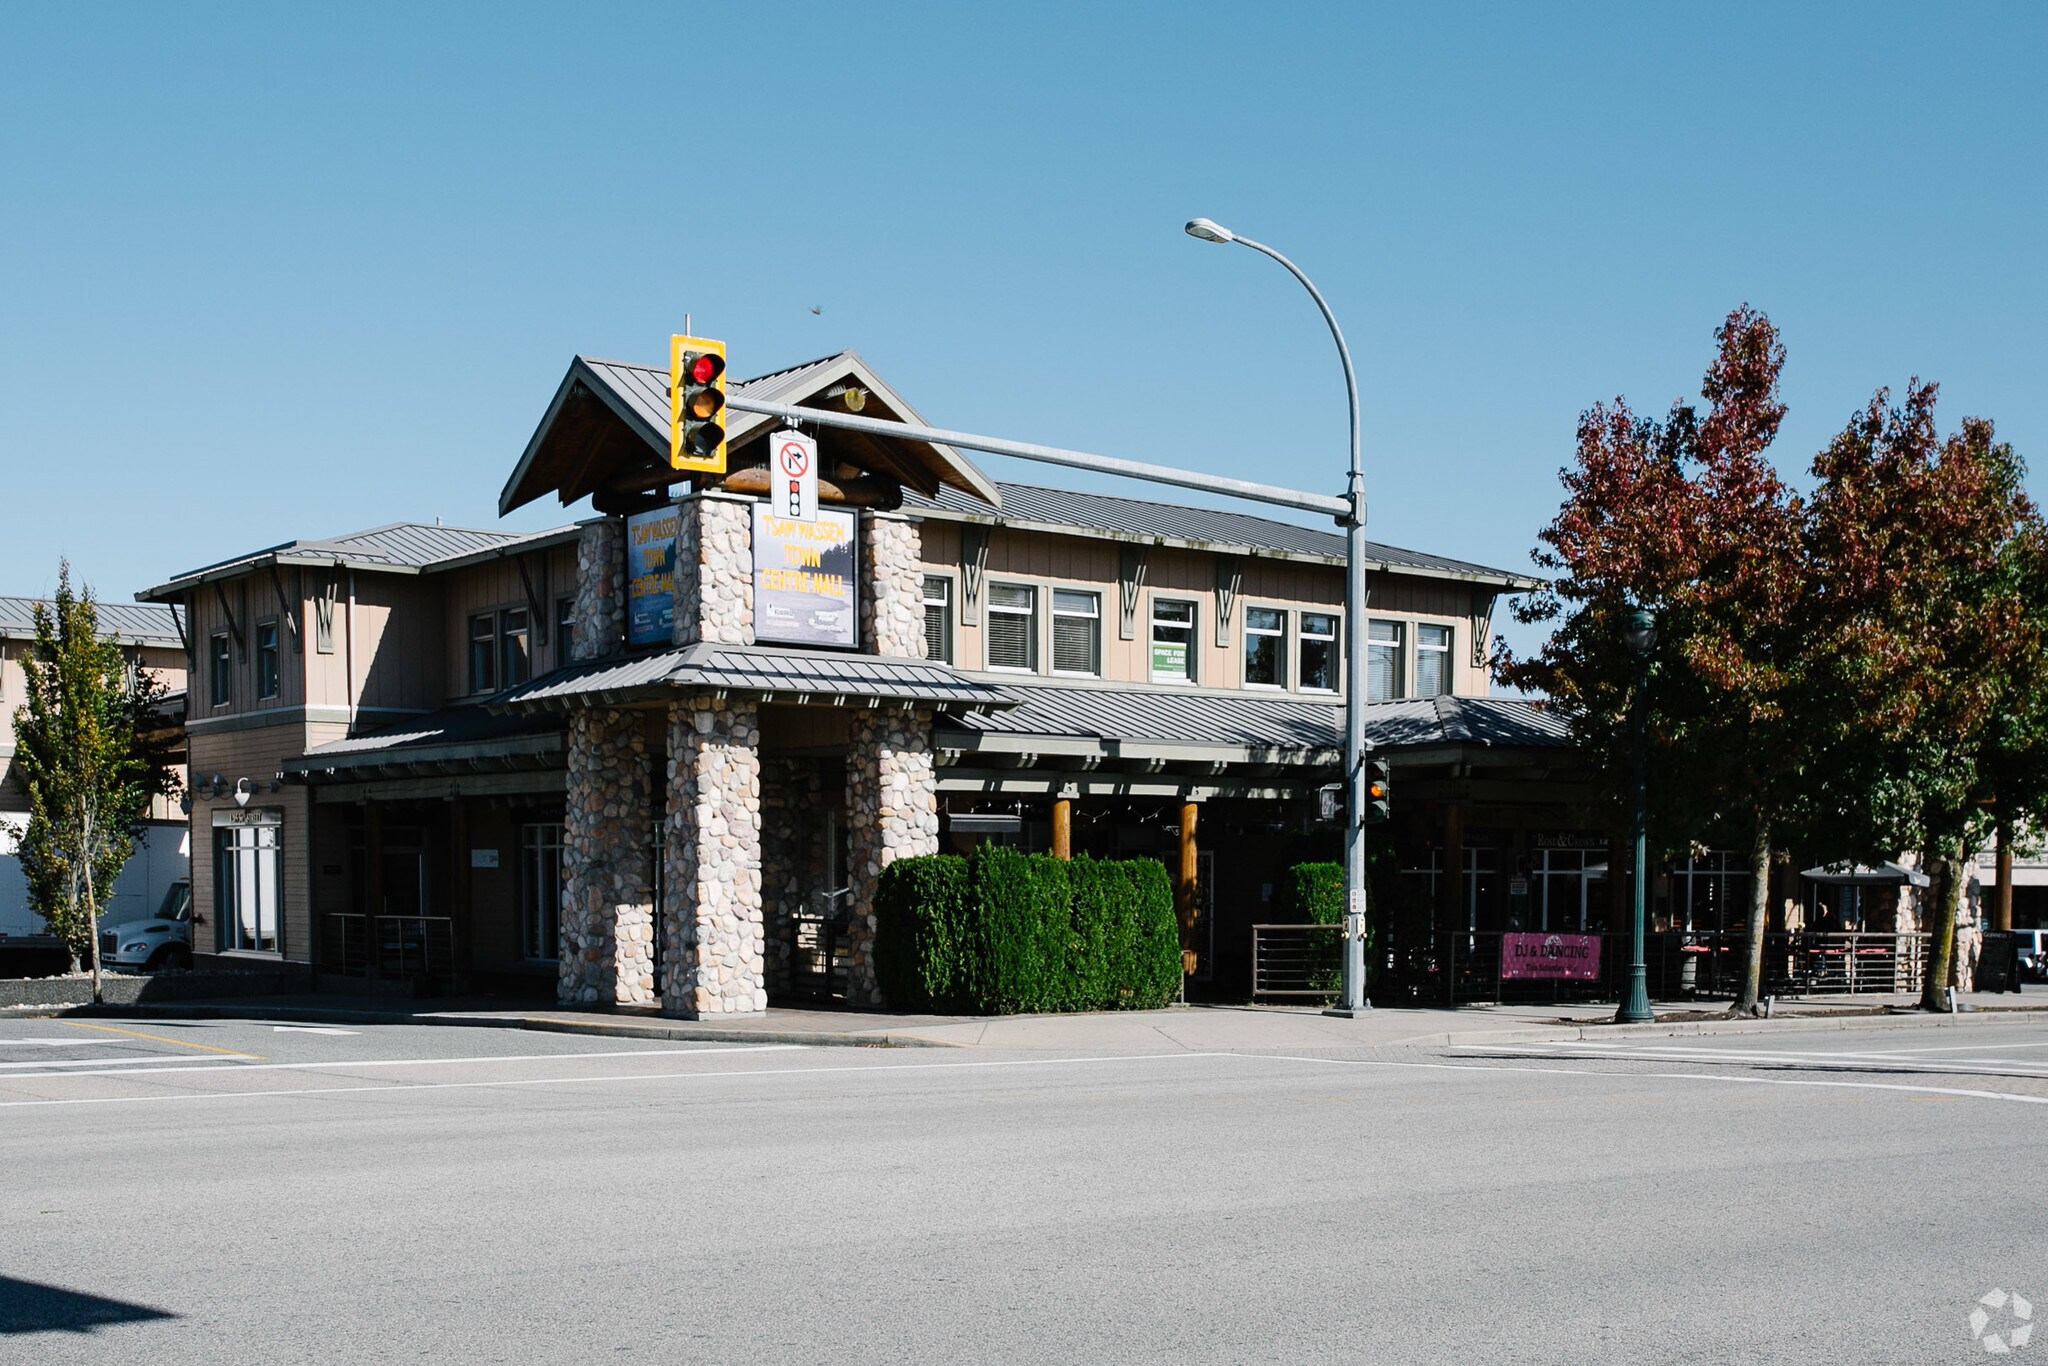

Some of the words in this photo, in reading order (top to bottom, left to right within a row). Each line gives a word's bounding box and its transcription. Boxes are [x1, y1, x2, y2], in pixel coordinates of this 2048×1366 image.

[631, 515, 678, 545] TSAWWASSE
[643, 547, 665, 568] TOWN
[783, 543, 821, 567] TOWN
[631, 574, 659, 598] CENTRE
[760, 568, 809, 592] CENTRE
[813, 573, 846, 596] MALL
[1154, 648, 1172, 656] SPACE
[1515, 944, 1529, 957] DJ
[1529, 945, 1537, 957] &
[1539, 945, 1589, 959] DANCING
